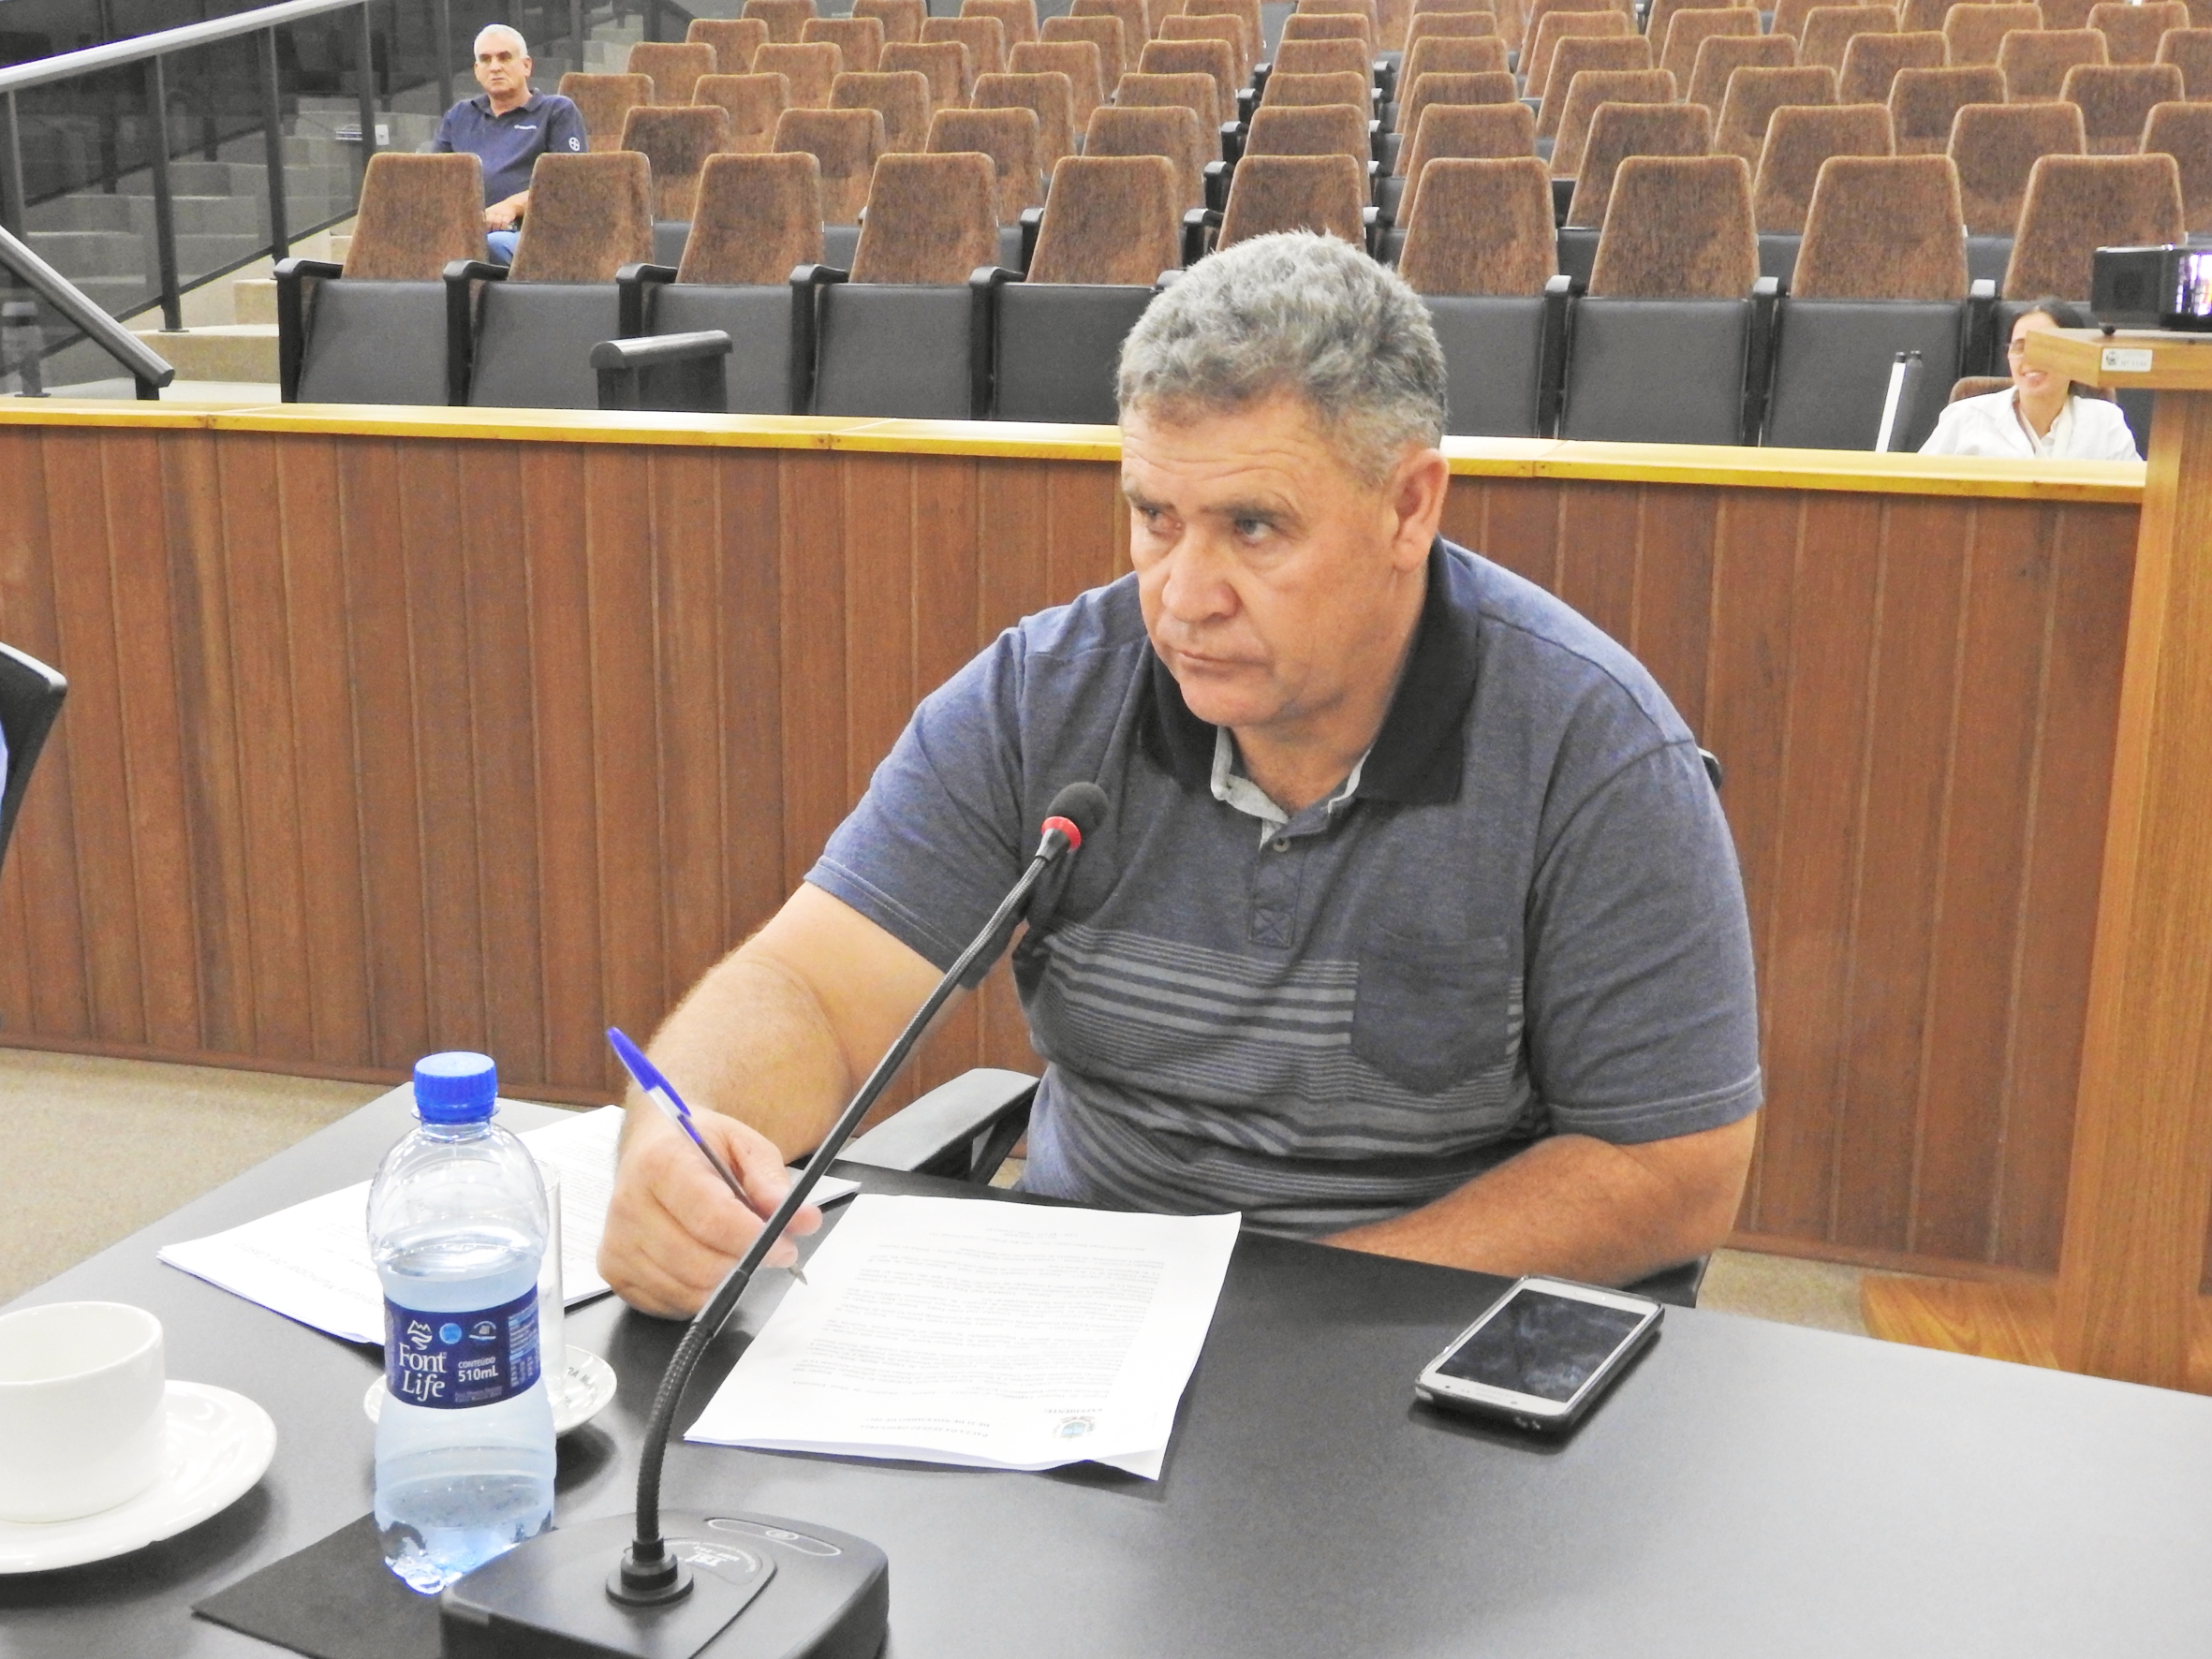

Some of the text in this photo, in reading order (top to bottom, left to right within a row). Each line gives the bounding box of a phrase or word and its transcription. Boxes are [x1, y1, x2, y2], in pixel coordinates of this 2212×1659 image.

[399, 1342, 447, 1373] Font
[458, 1357, 495, 1370] CONTEÚDO
[458, 1366, 498, 1382] 510mL
[402, 1370, 445, 1402] Life
